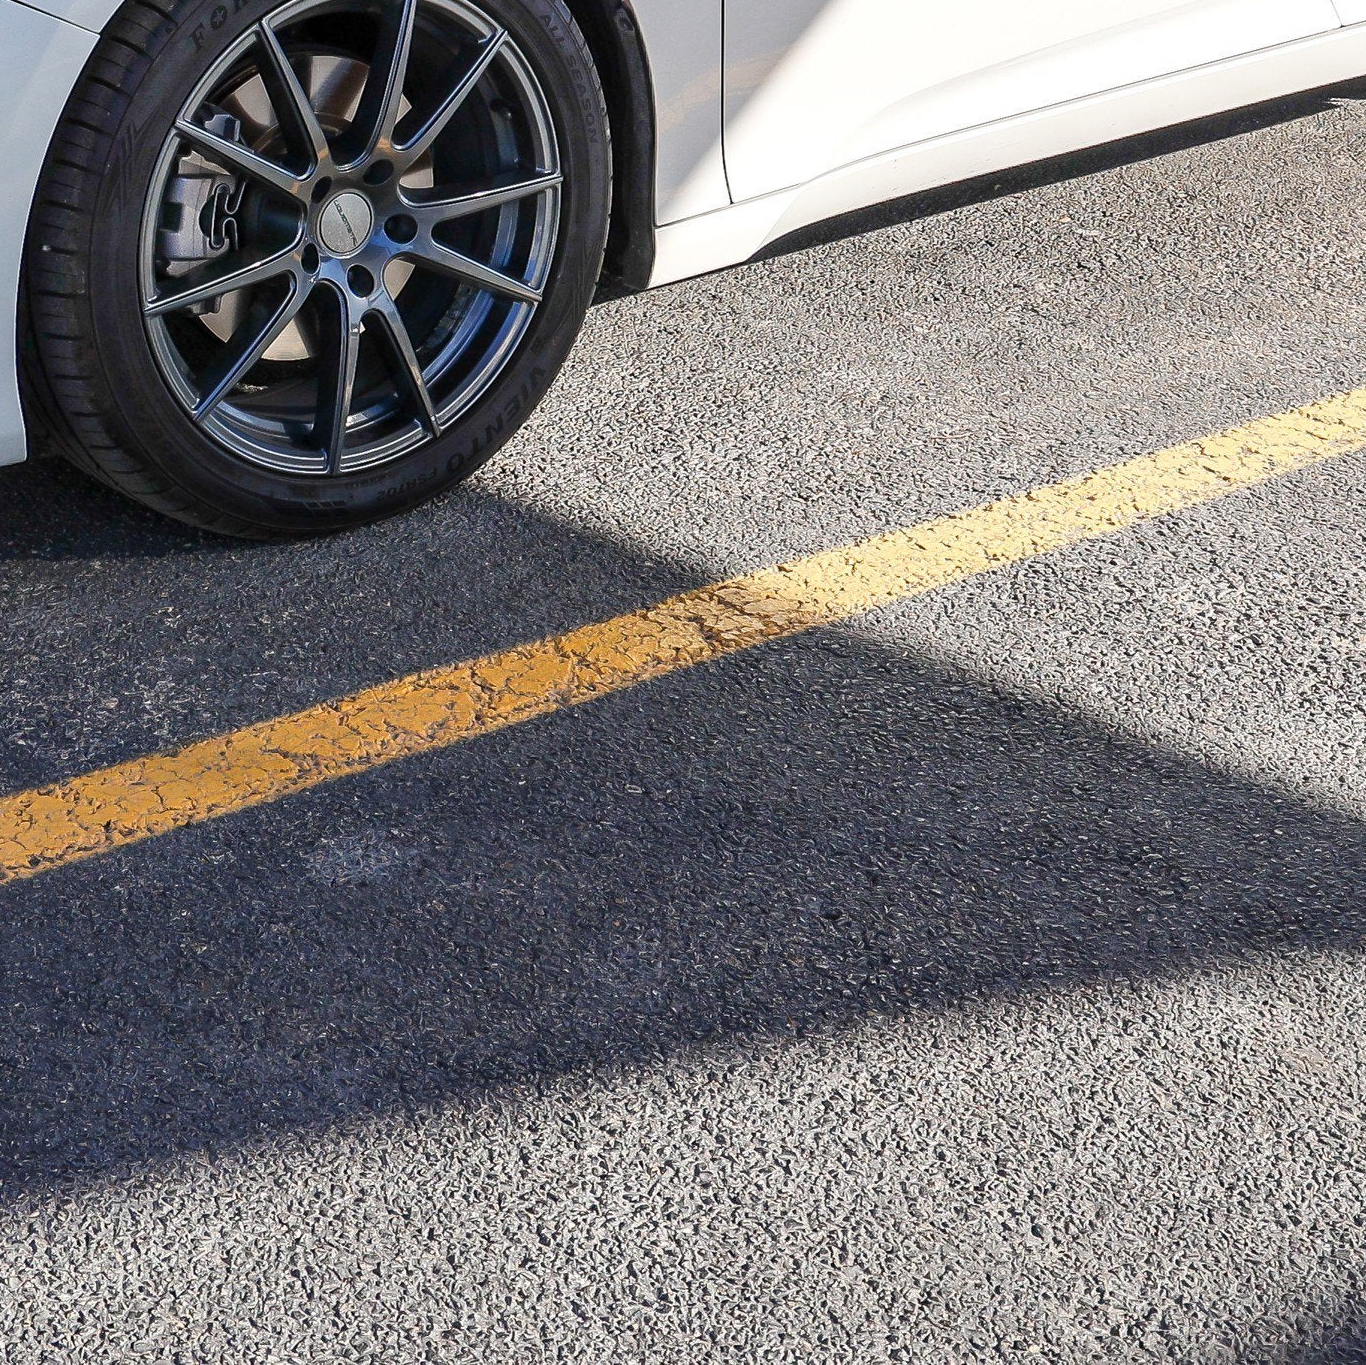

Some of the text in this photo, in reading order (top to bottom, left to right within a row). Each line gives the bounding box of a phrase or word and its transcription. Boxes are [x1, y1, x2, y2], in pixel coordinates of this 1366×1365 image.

[538, 14, 599, 145] ALL SEASON
[445, 366, 548, 474] VIENTO
